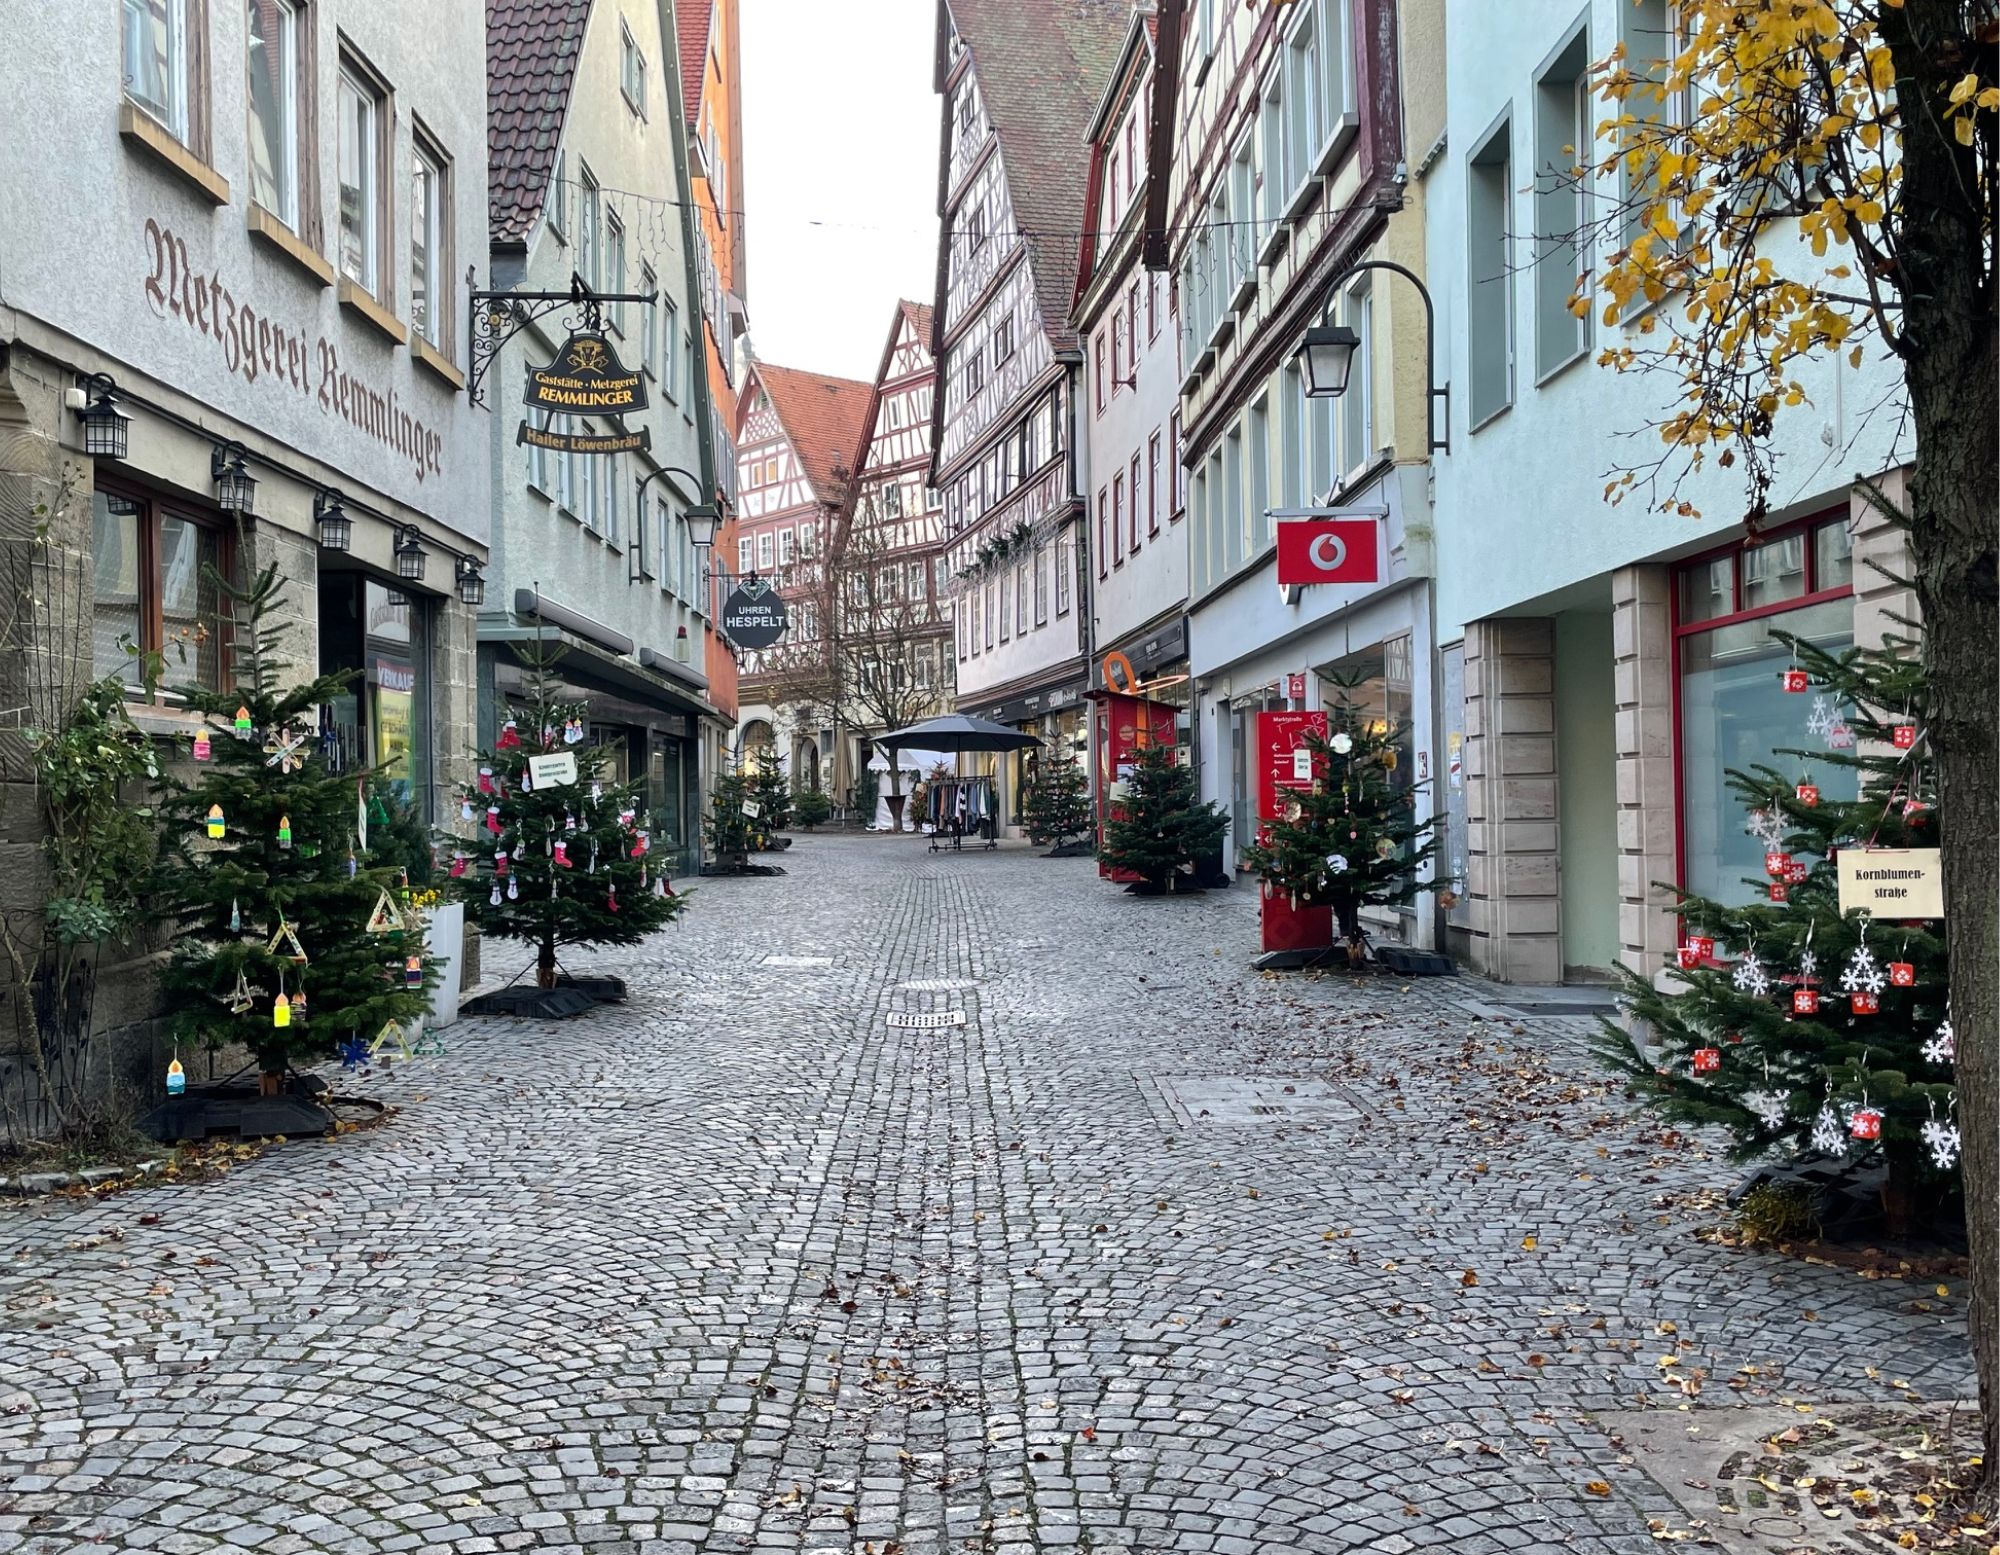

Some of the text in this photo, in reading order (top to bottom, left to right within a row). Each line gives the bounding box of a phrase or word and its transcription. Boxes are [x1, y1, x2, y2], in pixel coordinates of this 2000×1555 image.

[145, 218, 441, 485] Metzgerei Remmlinger
[535, 372, 639, 390] Gaststätte Metzgerei
[538, 386, 634, 406] REMMLINGER
[570, 436, 641, 451] Löwenbräu
[738, 606, 772, 615] UHREN
[726, 616, 784, 628] HESPELT
[1855, 868, 1926, 881] Kornblumen-
[1874, 886, 1908, 899] straße
